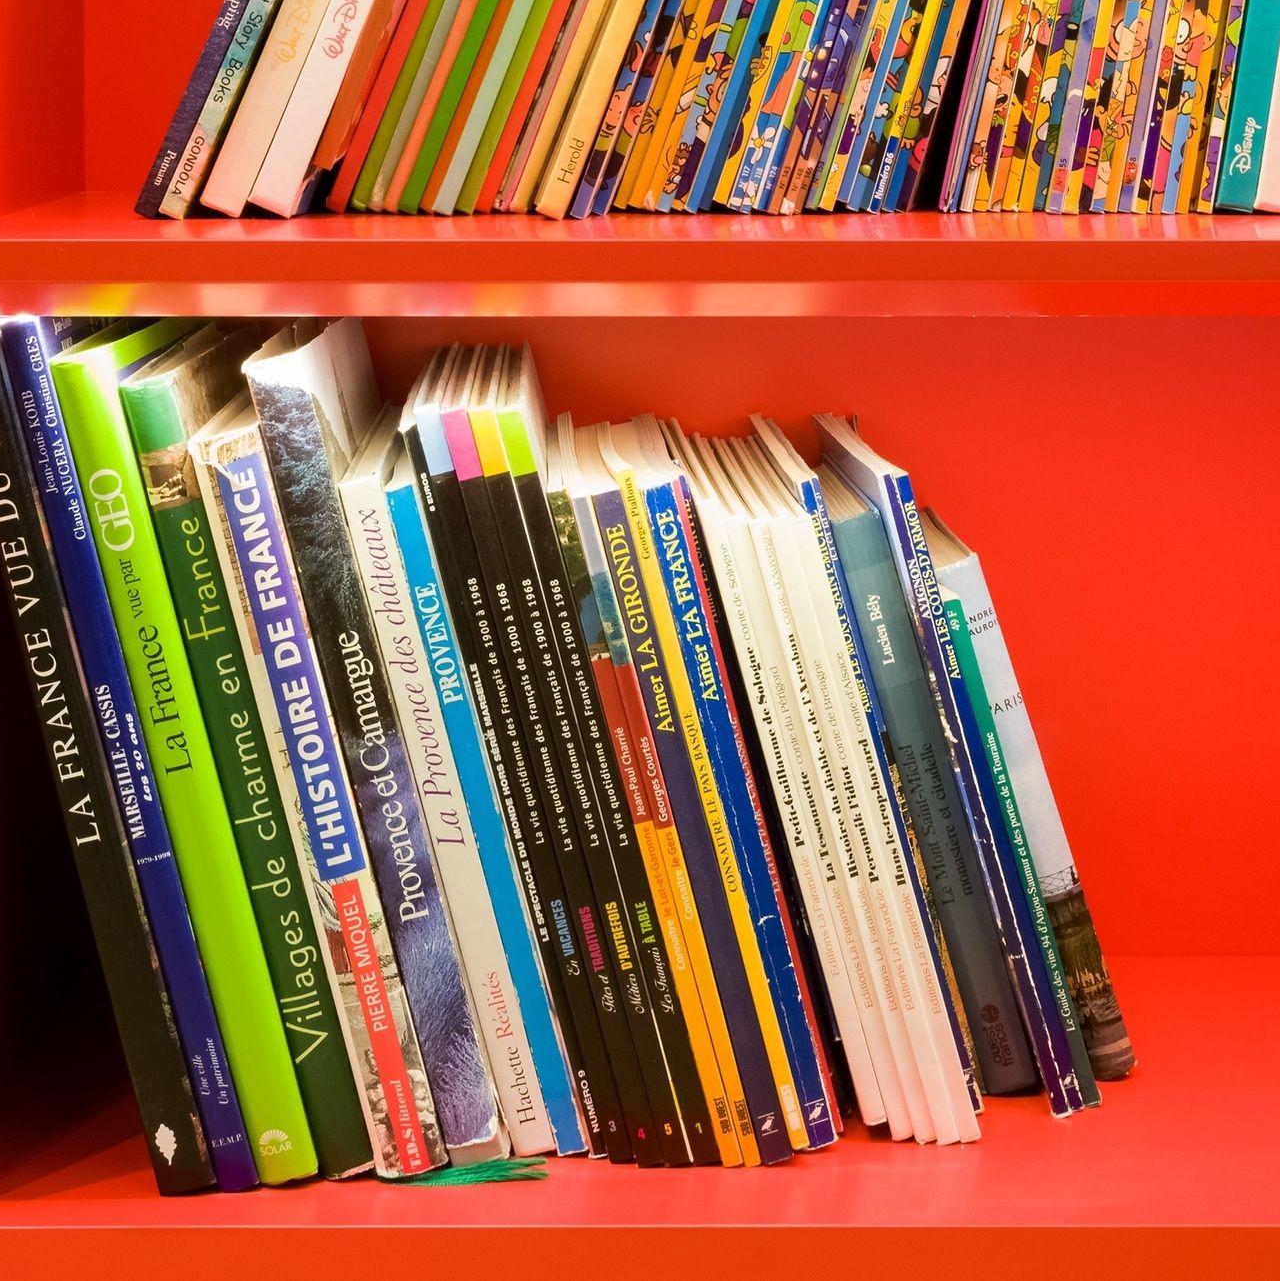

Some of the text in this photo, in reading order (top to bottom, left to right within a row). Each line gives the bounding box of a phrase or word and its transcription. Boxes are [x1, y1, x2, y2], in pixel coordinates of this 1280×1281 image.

[210, 56, 241, 106] Books
[232, 9, 261, 51] Story
[557, 136, 588, 185] Herold
[1, 533, 44, 614] VUE
[91, 462, 195, 775] La France vue par GEO
[414, 580, 466, 704] PROVENCE
[605, 521, 677, 735] Aimer LA GIRONDE
[24, 625, 87, 782] FRANCE
[227, 466, 355, 867] L'HISTOIRE DE FRANCE
[349, 504, 468, 851] La Provence des châteaux
[66, 791, 103, 845] LA
[170, 514, 340, 1064] Villages de charme en France
[332, 625, 433, 922] Provence et Camargue
